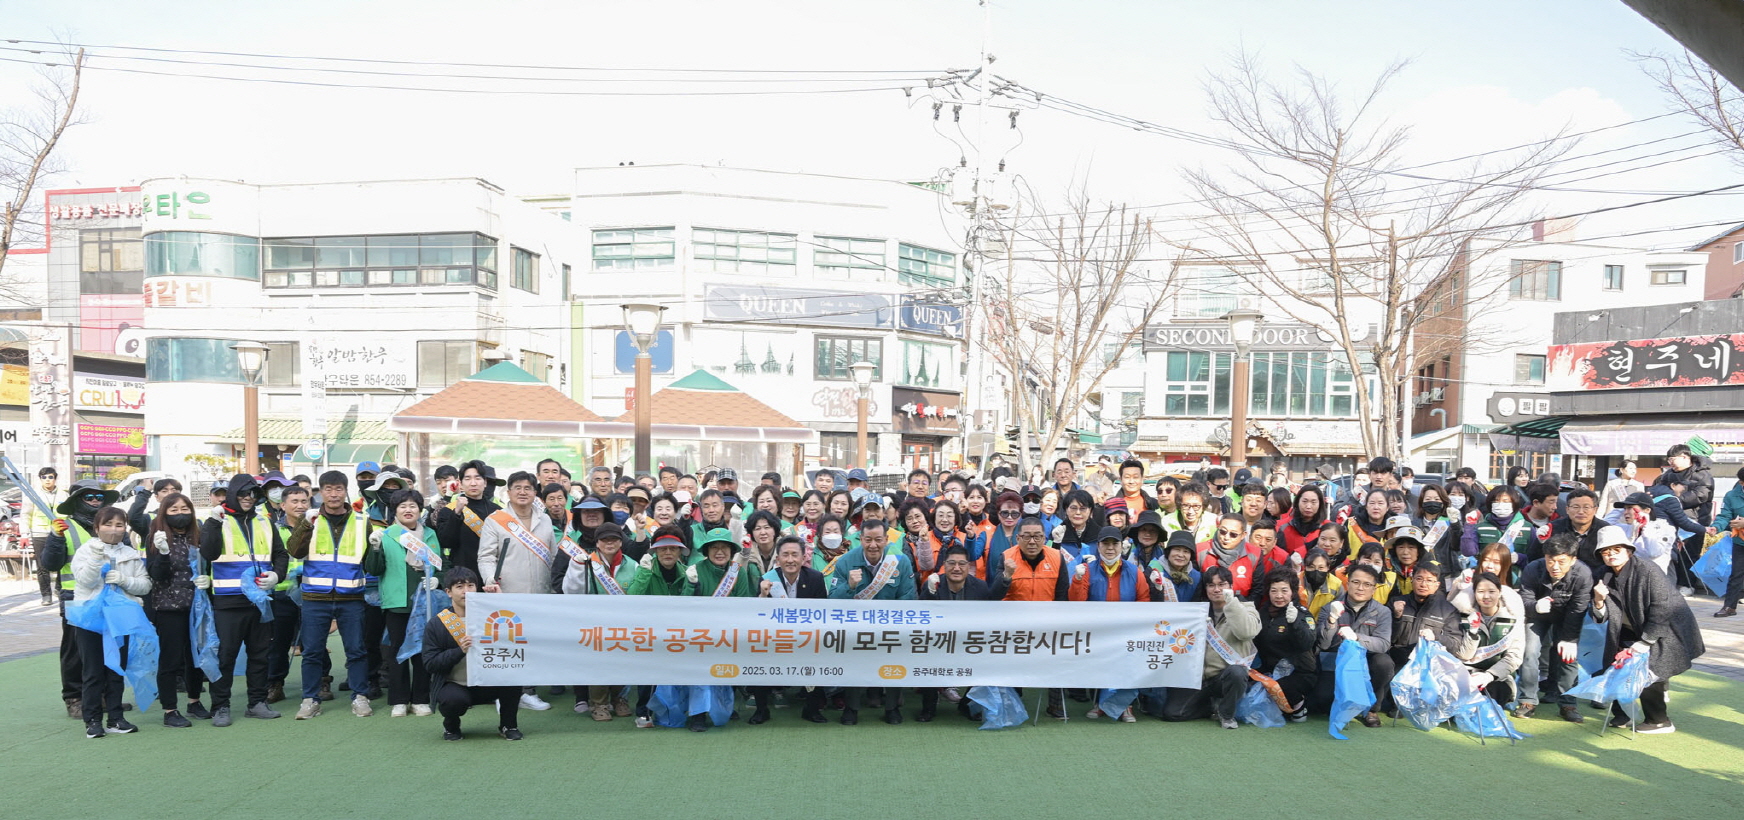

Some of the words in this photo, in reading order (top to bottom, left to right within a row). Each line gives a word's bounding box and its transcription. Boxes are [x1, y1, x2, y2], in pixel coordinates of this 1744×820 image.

[740, 292, 806, 315] QUEEN
[912, 302, 953, 327] QUEEN
[1607, 339, 1731, 386] 현주네
[770, 608, 827, 624] 새봄맞이
[830, 608, 859, 624] 국토
[862, 609, 932, 625] 대청결운동
[577, 626, 656, 653] 깨끗한
[662, 628, 738, 653] 공주시
[747, 628, 847, 655] 만들기에
[852, 630, 903, 654] 모두
[908, 630, 957, 655] 함께
[962, 630, 1092, 656] 동참합시다!
[1126, 639, 1165, 653] 흥미진진
[481, 647, 525, 663] 공주시
[1146, 655, 1174, 671] 공주
[482, 662, 509, 670] GONGJU
[510, 662, 525, 670] CITY
[714, 664, 735, 677] 일시
[742, 665, 767, 677] 2025.
[769, 665, 783, 677] 03.
[784, 665, 816, 678] 17.(월)
[818, 665, 844, 677] 16:00
[882, 665, 903, 678] 장소
[912, 666, 954, 678] 공주대학로
[955, 666, 973, 678] 공원
